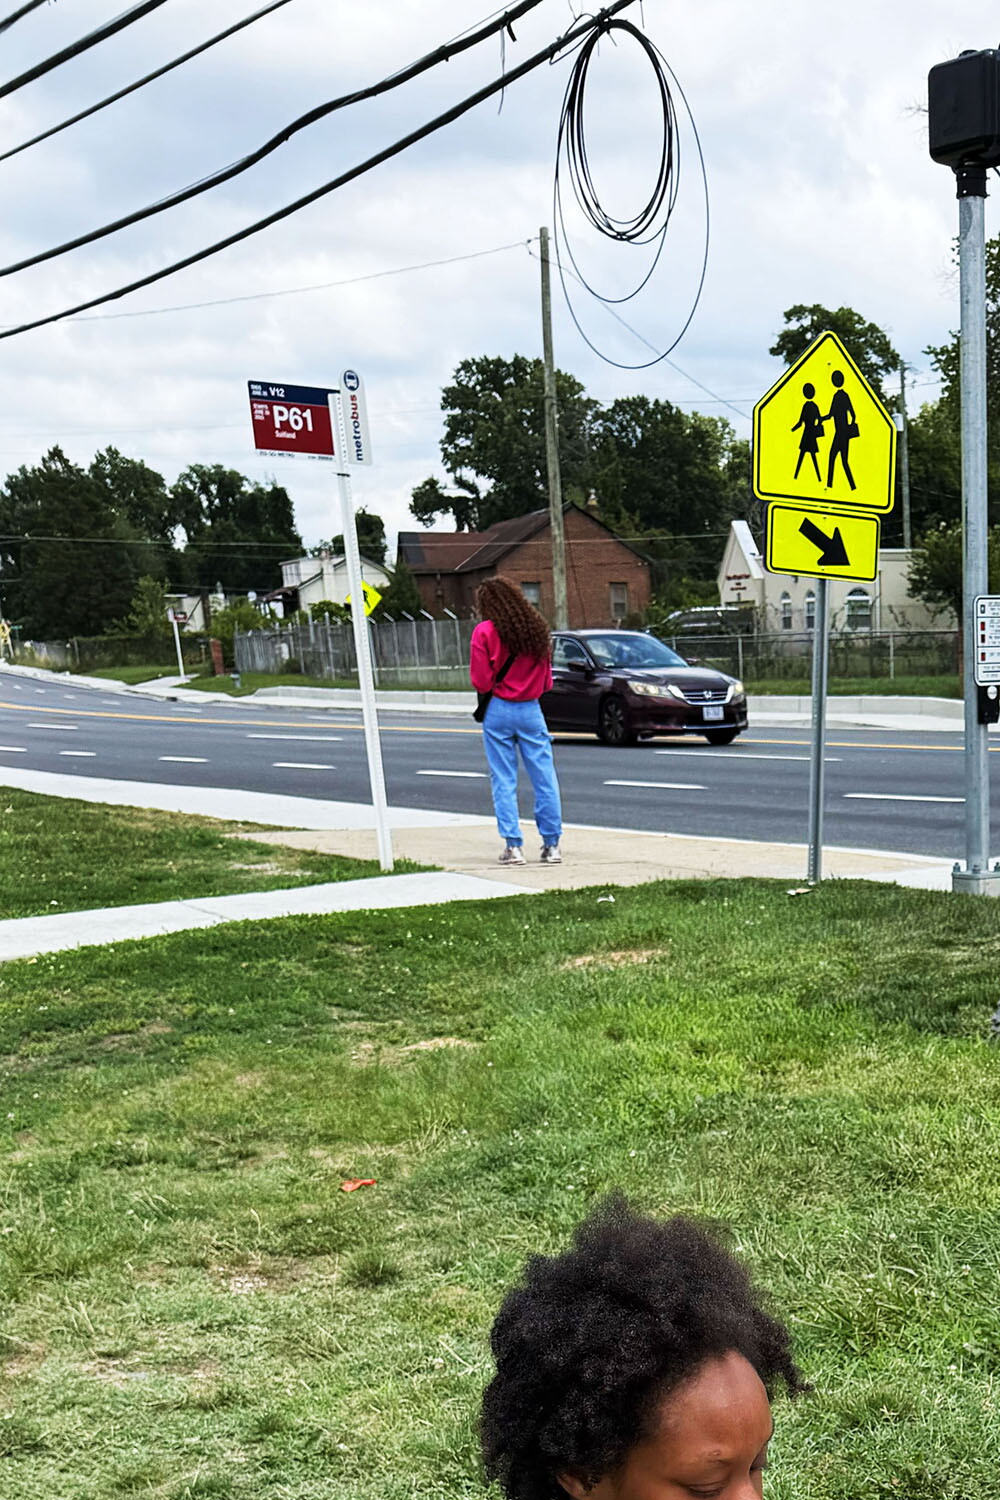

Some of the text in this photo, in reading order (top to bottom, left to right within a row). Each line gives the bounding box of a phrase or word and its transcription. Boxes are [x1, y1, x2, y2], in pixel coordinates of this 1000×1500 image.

[269, 386, 285, 398] V12
[272, 404, 313, 432] P61
[350, 394, 364, 461] metrobus
